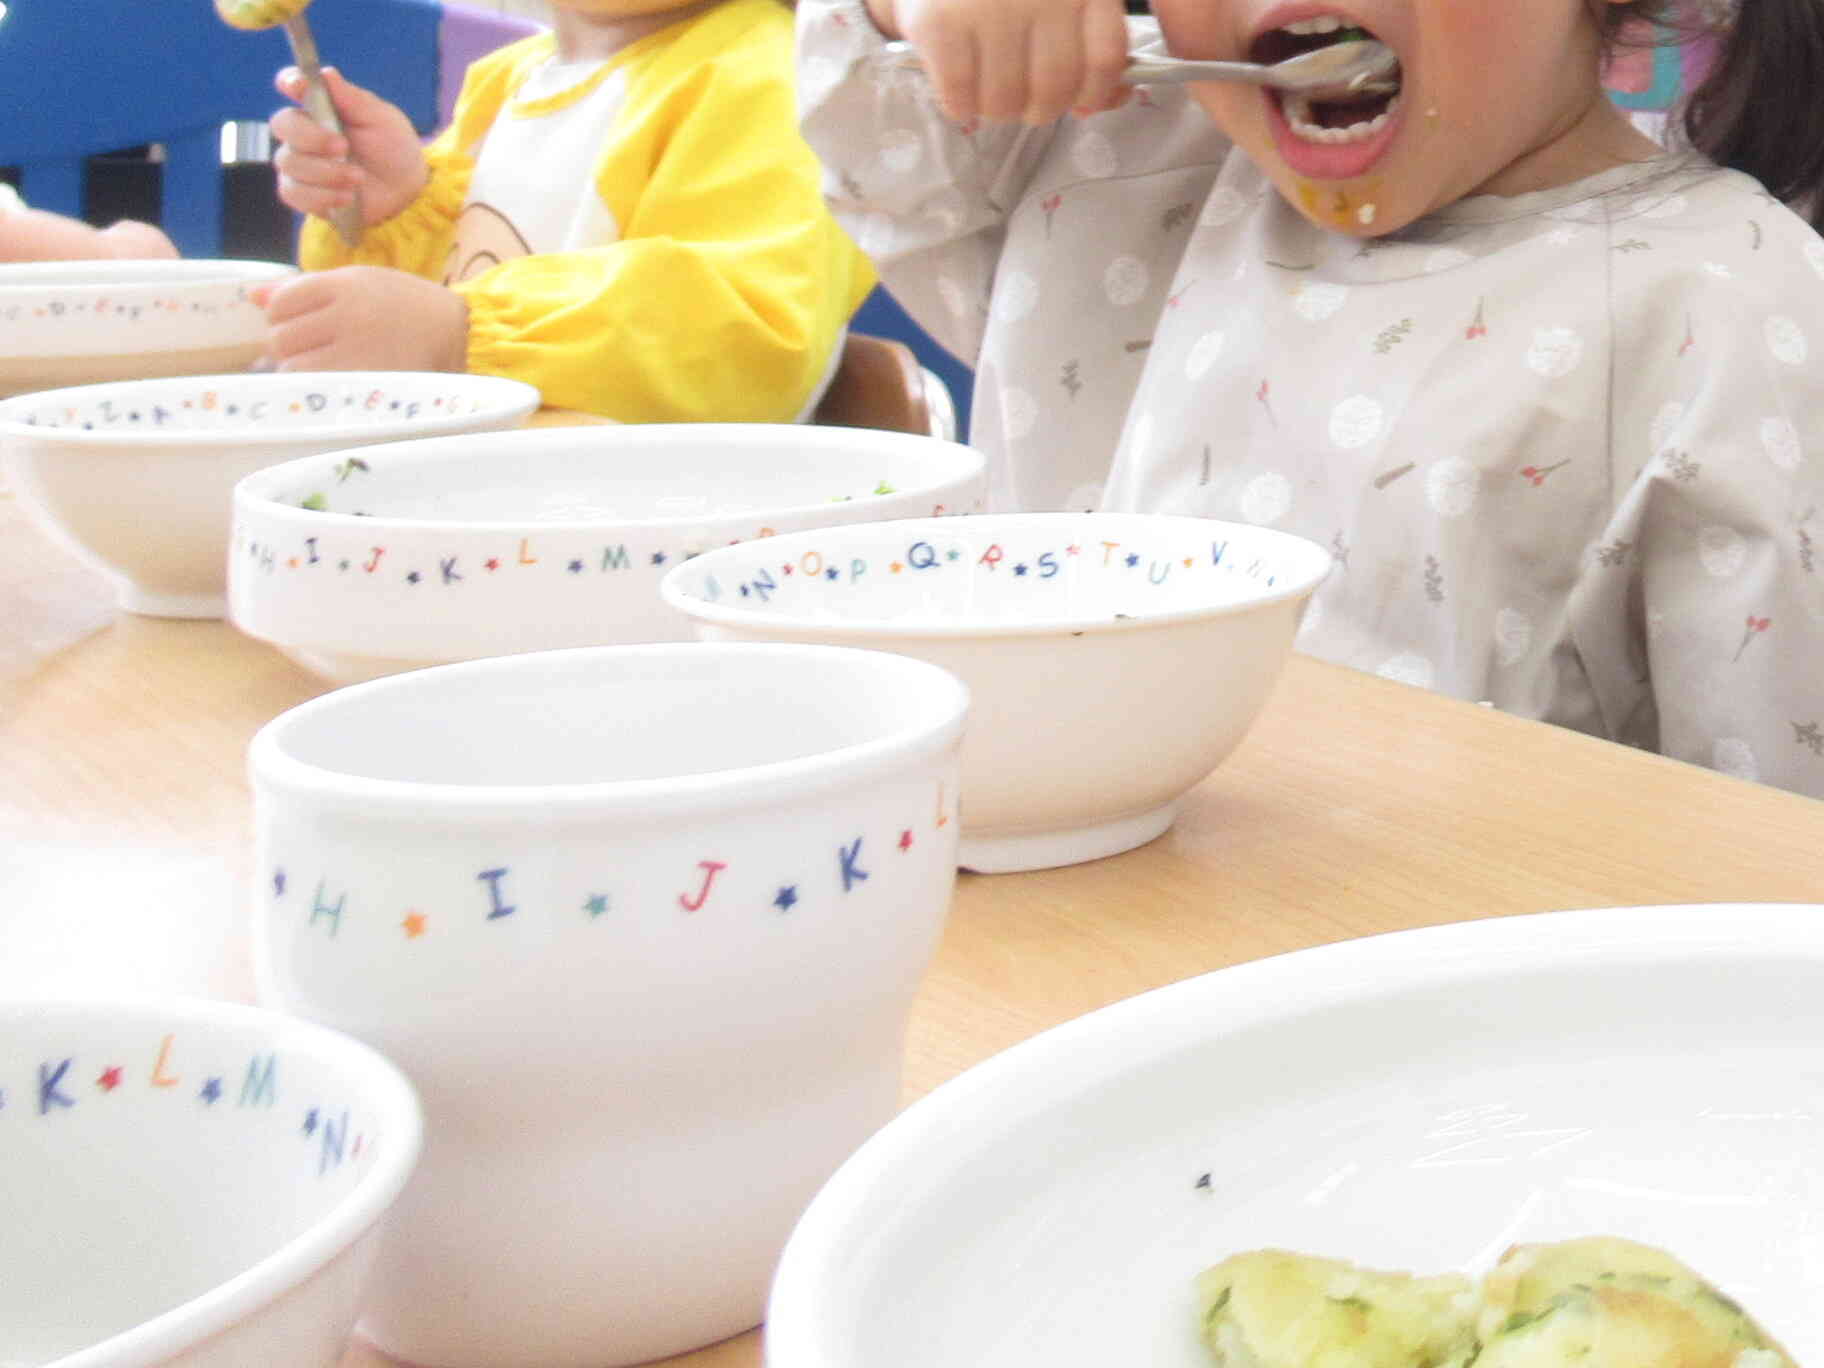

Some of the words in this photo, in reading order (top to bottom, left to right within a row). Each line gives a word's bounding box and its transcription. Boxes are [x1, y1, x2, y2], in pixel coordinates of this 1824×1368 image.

[306, 537, 319, 564] I
[363, 547, 385, 574] J
[440, 558, 462, 584] K
[518, 539, 538, 566] L
[601, 544, 630, 572] M
[751, 569, 776, 602] N
[799, 552, 826, 580] O
[850, 558, 867, 584] P
[908, 542, 940, 570] Q
[978, 544, 1003, 571] R
[1038, 552, 1059, 578] S
[1100, 541, 1120, 566] T
[1148, 560, 1171, 585] U
[1212, 542, 1227, 566] V
[308, 880, 347, 940] H
[477, 868, 516, 921] I
[677, 860, 727, 913] J
[838, 837, 869, 893] K
[38, 1057, 77, 1116] K
[150, 1033, 180, 1087] L
[238, 1052, 280, 1109] M
[318, 1109, 349, 1176] N
